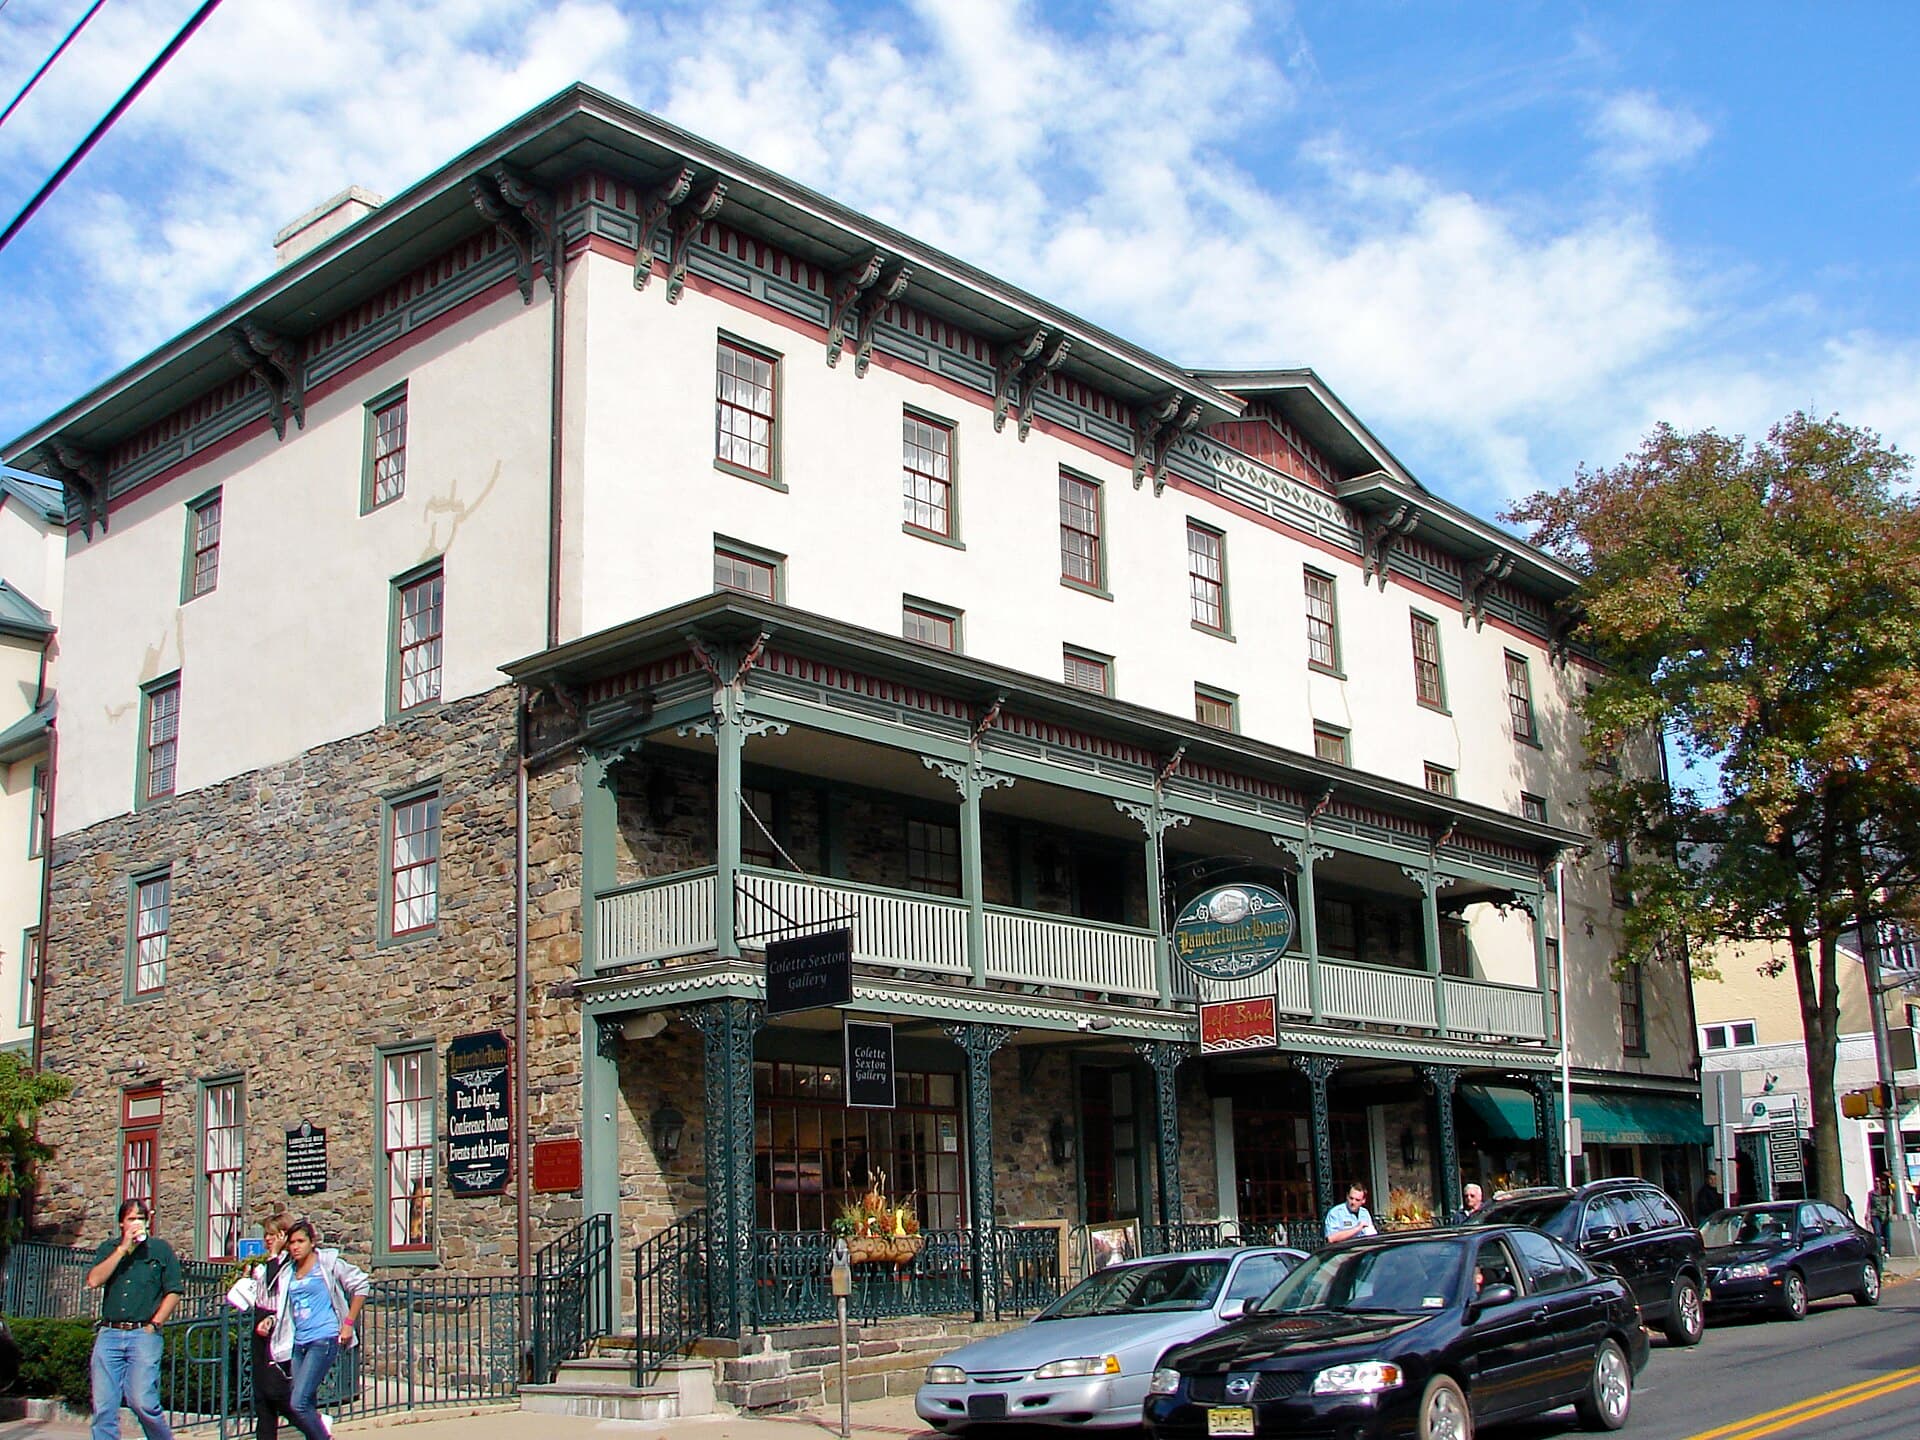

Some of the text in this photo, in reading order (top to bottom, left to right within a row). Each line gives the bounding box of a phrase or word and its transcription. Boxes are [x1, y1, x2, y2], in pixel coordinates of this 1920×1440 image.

[1177, 924, 1250, 955] Lambertville
[769, 951, 845, 975] Colette Sexton
[788, 973, 827, 992] Gallery
[1234, 999, 1273, 1024] Bank
[854, 1046, 886, 1059] Colette
[855, 1058, 886, 1070] Sexton
[855, 1069, 887, 1085] Gallery
[456, 1087, 500, 1110] Fine Lodging
[450, 1112, 509, 1136] Conference Rooms
[450, 1138, 510, 1162] Events at the Livery
